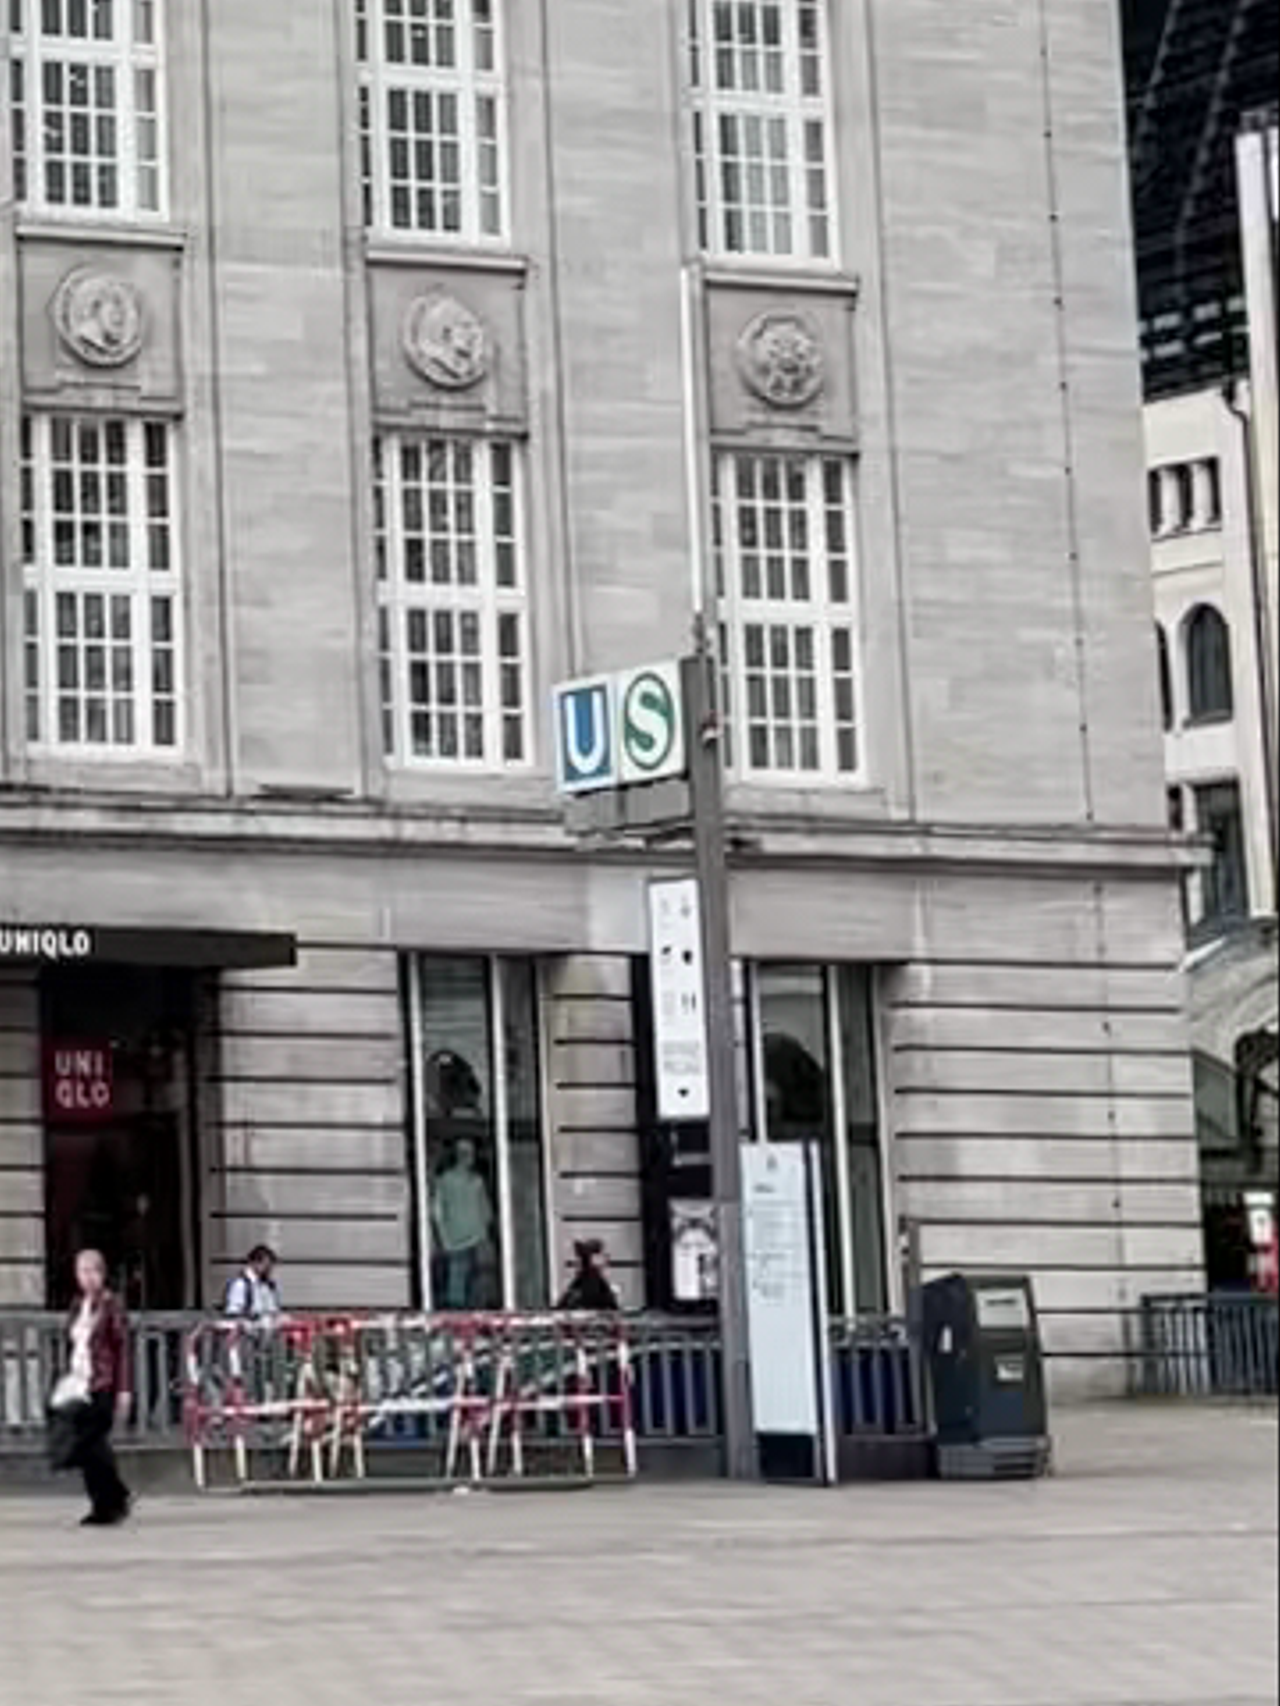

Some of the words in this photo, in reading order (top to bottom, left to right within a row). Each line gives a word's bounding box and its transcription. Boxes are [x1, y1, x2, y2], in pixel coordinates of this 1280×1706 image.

[566, 690, 604, 774] U
[627, 675, 671, 766] S
[55, 1050, 103, 1076] UNI
[55, 1079, 111, 1109] QLO
